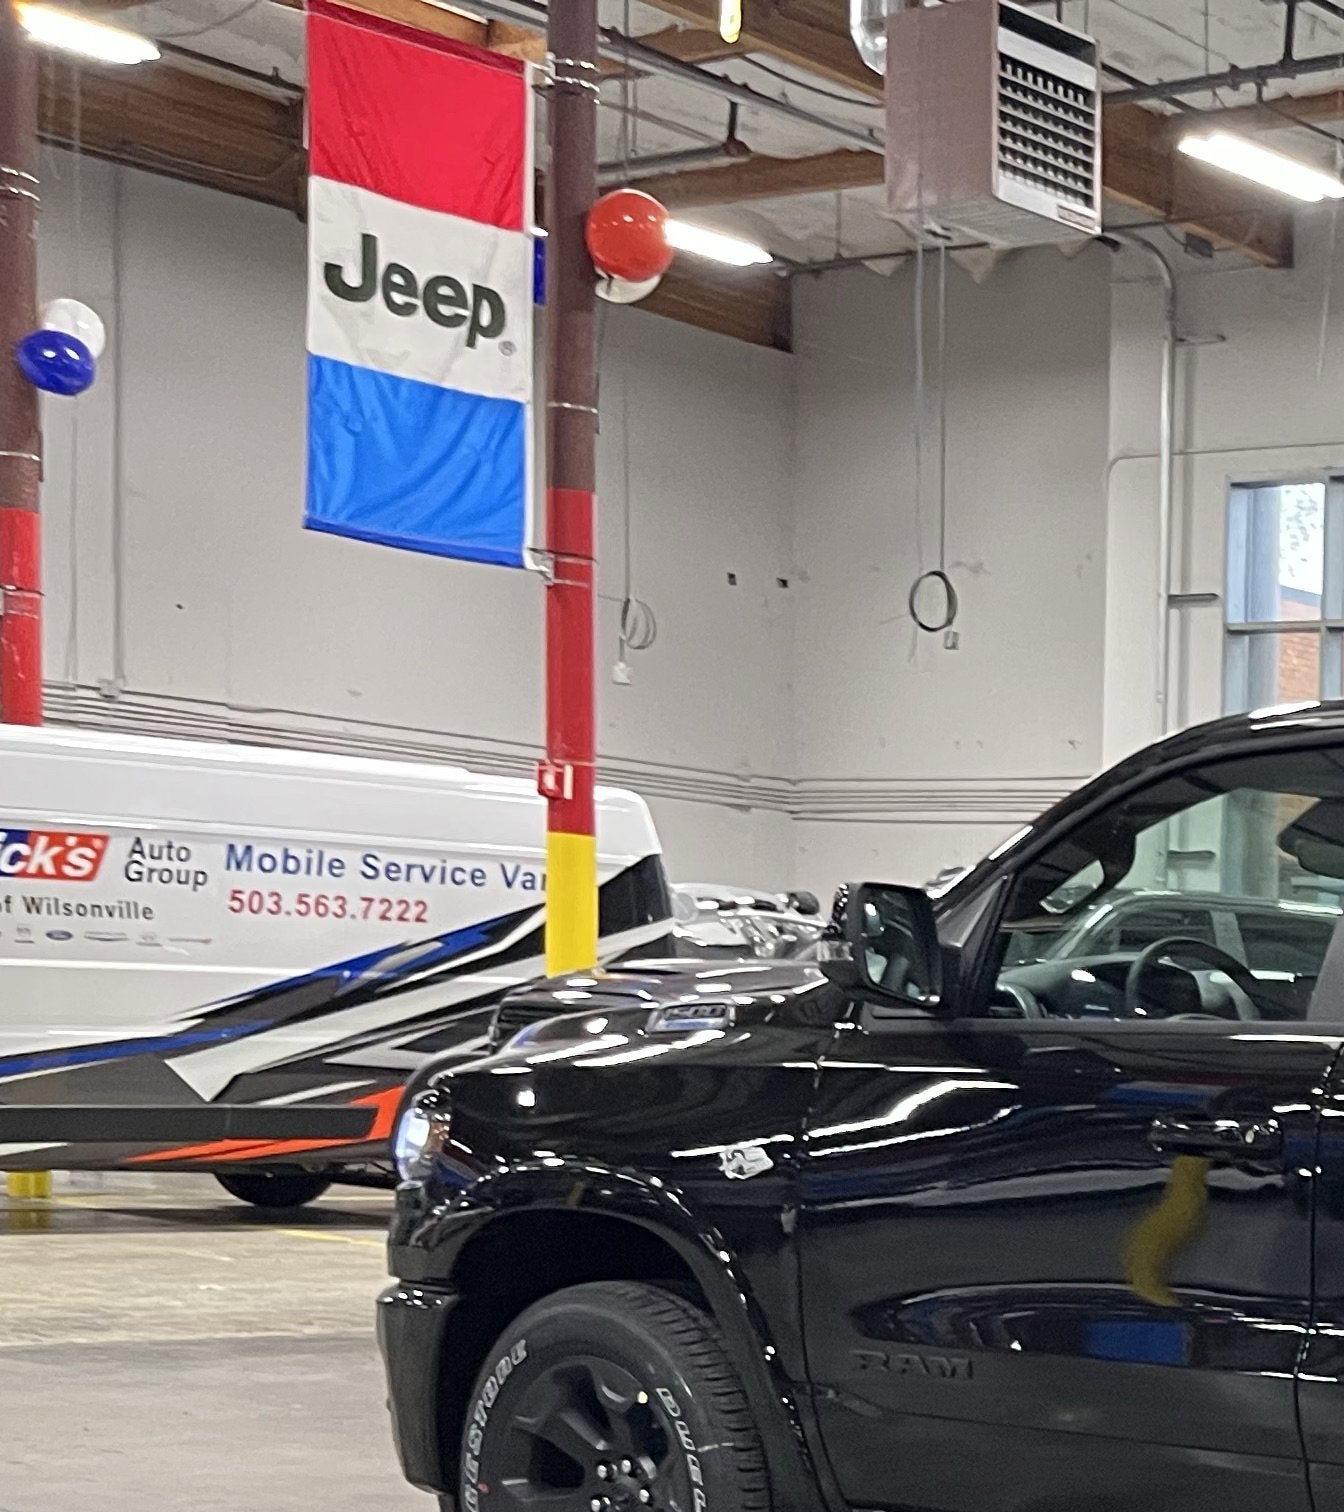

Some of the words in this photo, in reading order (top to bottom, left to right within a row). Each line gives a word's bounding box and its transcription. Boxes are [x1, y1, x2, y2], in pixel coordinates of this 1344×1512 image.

[128, 837, 192, 862] Auto
[225, 843, 346, 878] Mobile
[360, 853, 487, 887] Service
[124, 860, 208, 892] Group
[22, 895, 154, 920] Wilsonville
[228, 889, 428, 923] 503.563.7222
